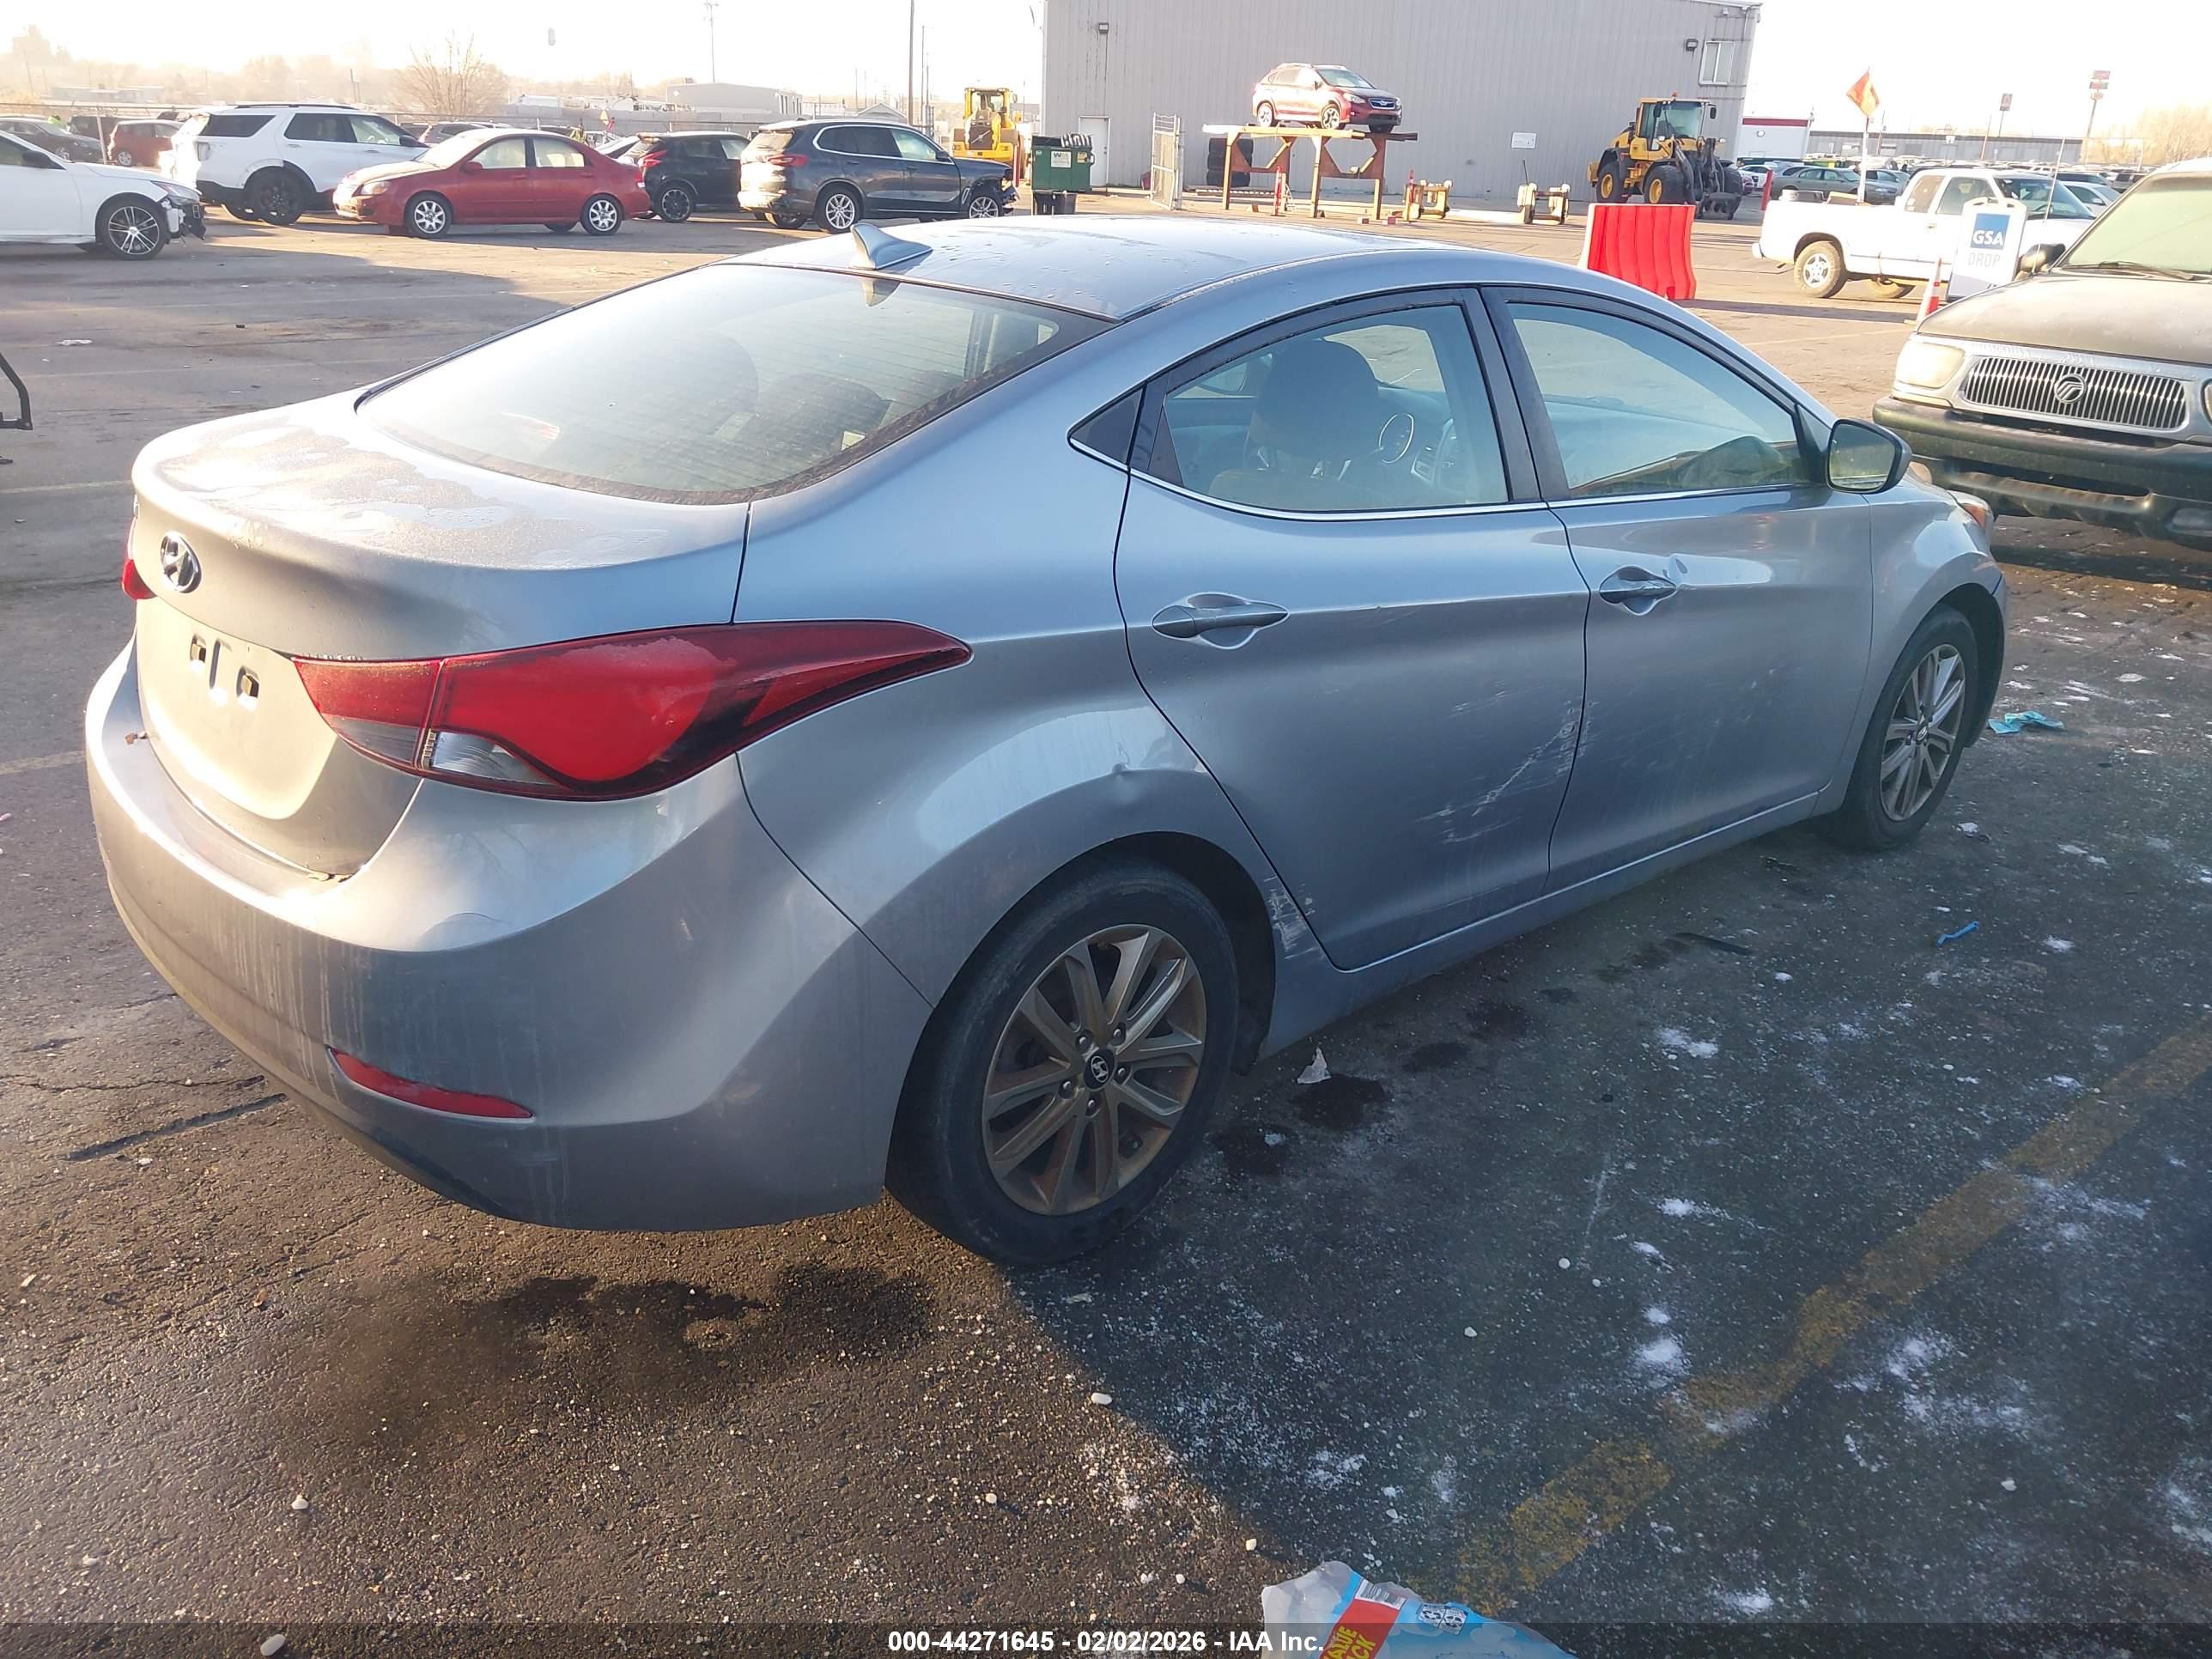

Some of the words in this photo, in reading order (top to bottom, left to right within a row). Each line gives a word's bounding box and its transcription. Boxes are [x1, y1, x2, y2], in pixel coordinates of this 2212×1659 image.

[1972, 229, 2004, 246] GSA
[1967, 252, 2002, 268] DROP
[1322, 1625, 1358, 1659] ALUE
[1346, 1634, 1376, 1659] CK
